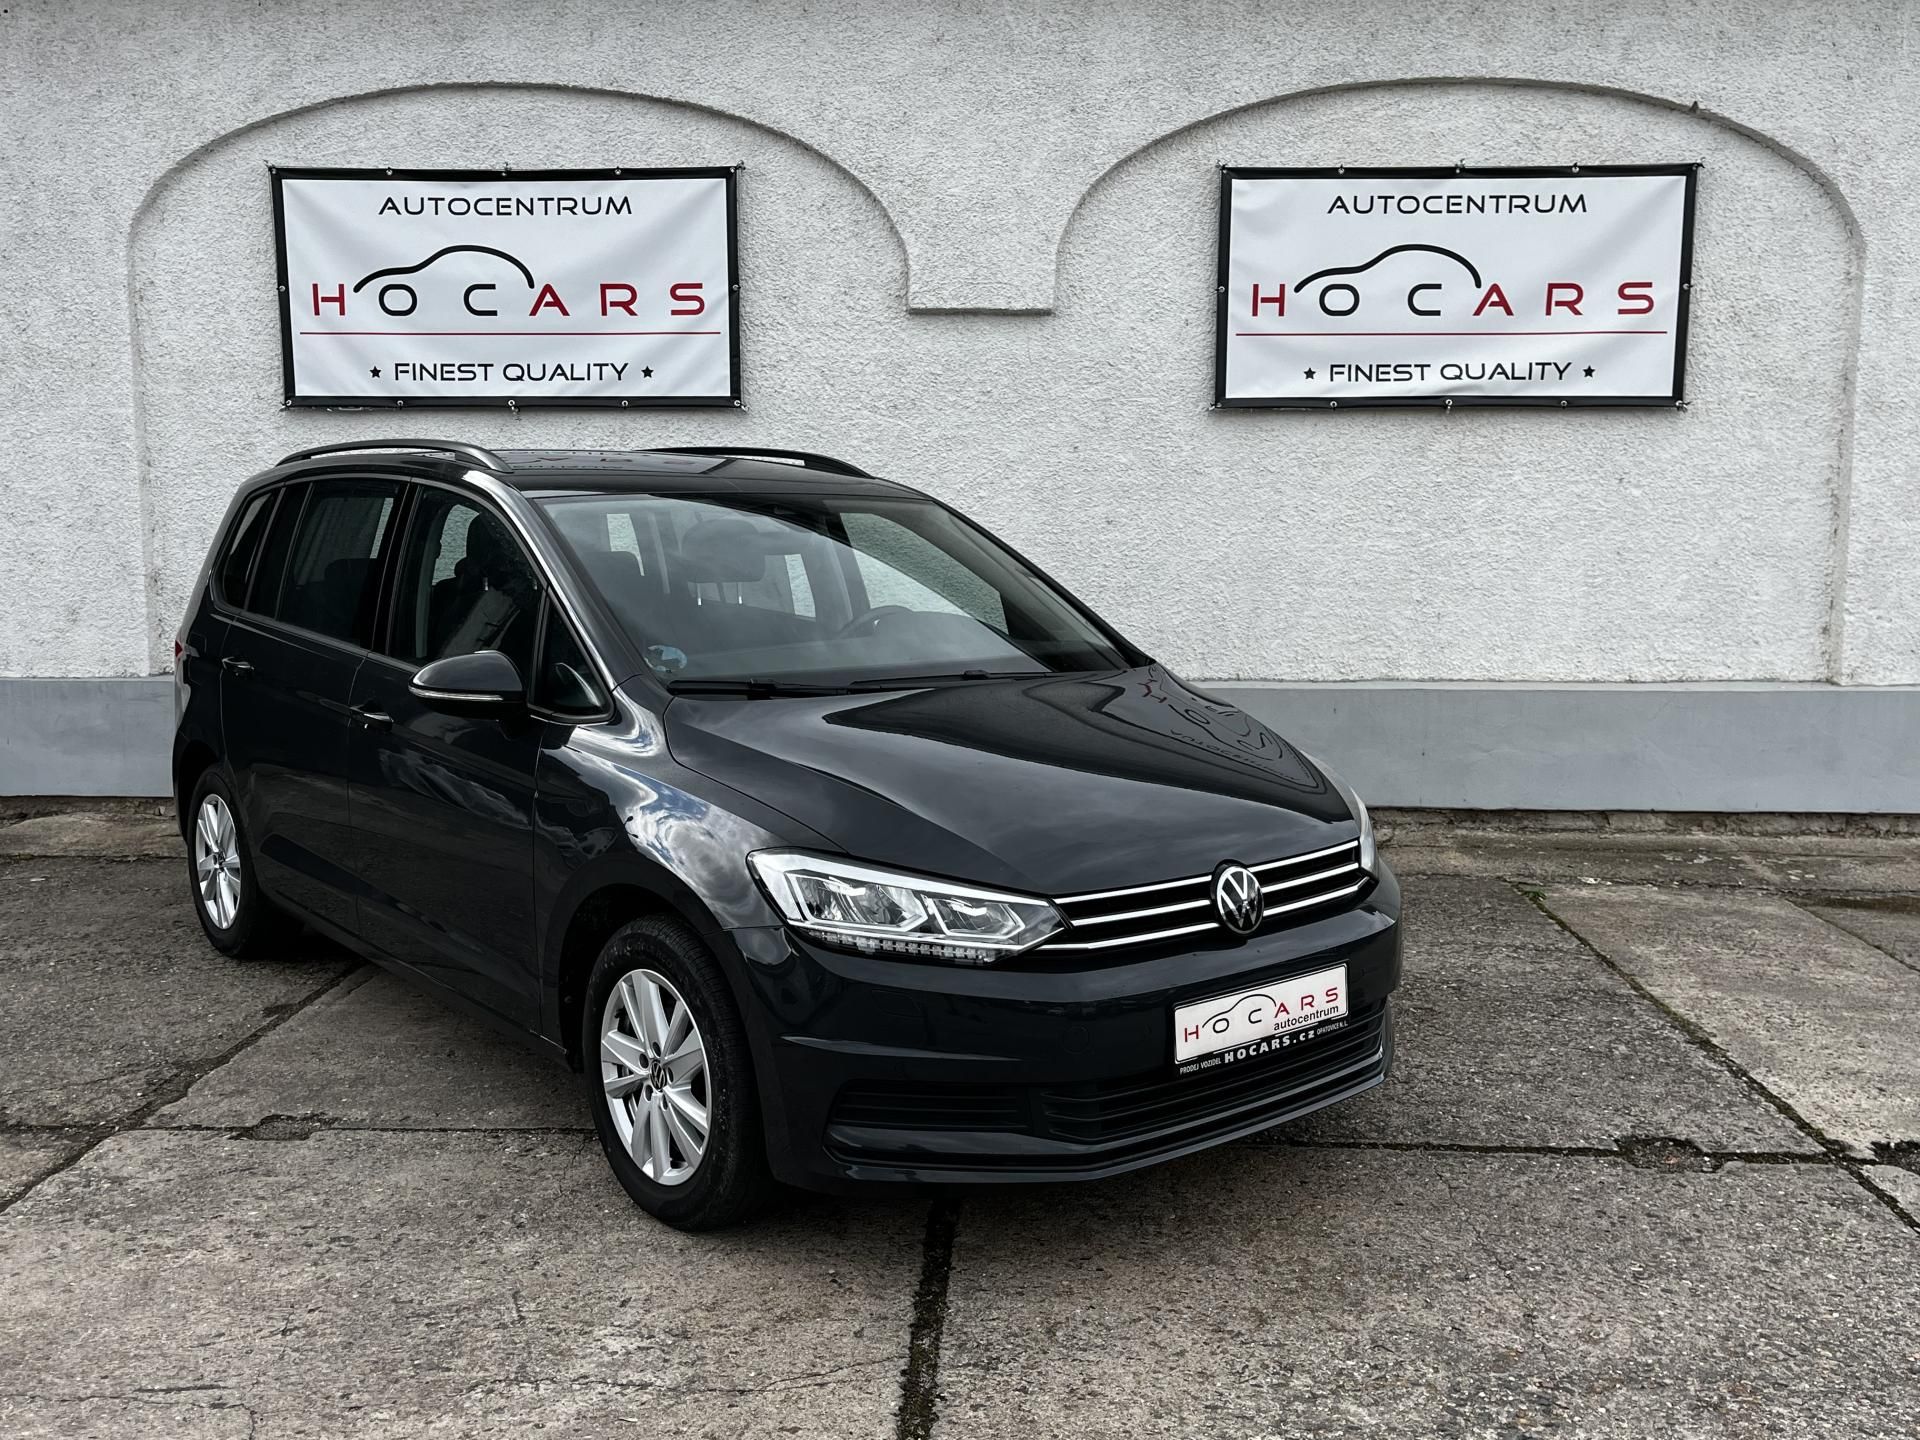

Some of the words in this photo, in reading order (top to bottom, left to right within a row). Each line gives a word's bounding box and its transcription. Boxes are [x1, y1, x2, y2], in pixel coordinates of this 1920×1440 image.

[377, 195, 633, 217] AUTOCENTRUM
[1327, 193, 1587, 215] AUTOCENTRUM
[394, 363, 495, 383] FINEST
[502, 362, 629, 383] QUALITY
[1329, 363, 1431, 383] FINEST
[1440, 361, 1572, 382] QUALITY
[1273, 1005, 1339, 1032] autocentrum
[1224, 1029, 1316, 1064] HOCARS.cz
